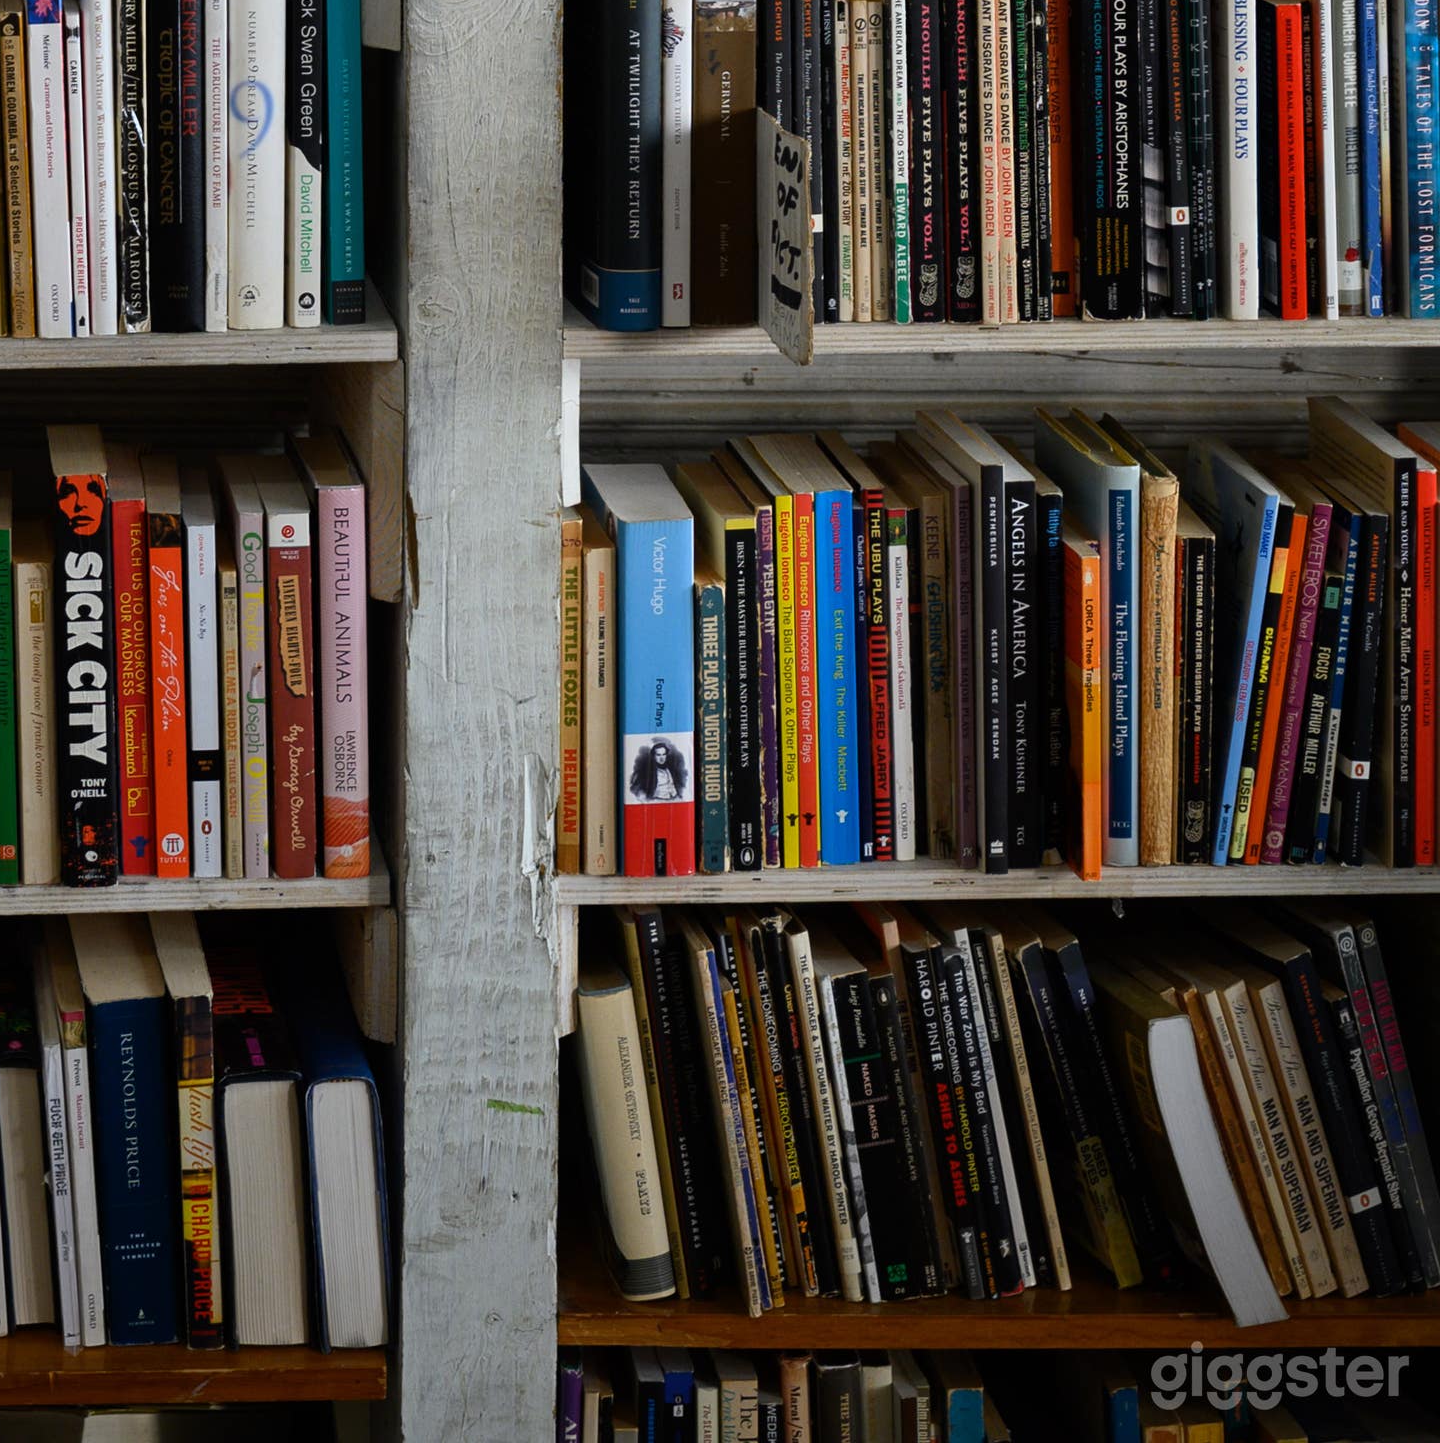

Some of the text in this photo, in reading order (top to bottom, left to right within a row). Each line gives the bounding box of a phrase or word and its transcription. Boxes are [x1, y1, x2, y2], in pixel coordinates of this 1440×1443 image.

[1115, 36, 1127, 74] PLAYS
[1115, 80, 1128, 97] BY
[627, 30, 641, 239] AT TWILIGHT THEY RETURN
[1115, 101, 1129, 209] ARISTOPHANES
[653, 537, 667, 614] Victor Hugo
[1011, 573, 1028, 591] IN
[64, 550, 107, 765] SICK CITY
[563, 749, 579, 833] HELLMAN
[916, 959, 944, 1072] HAROLD PINTER
[120, 1032, 141, 1189] REYNOLDS PRICE
[1294, 1095, 1345, 1231] MAN AND SUPERMAN
